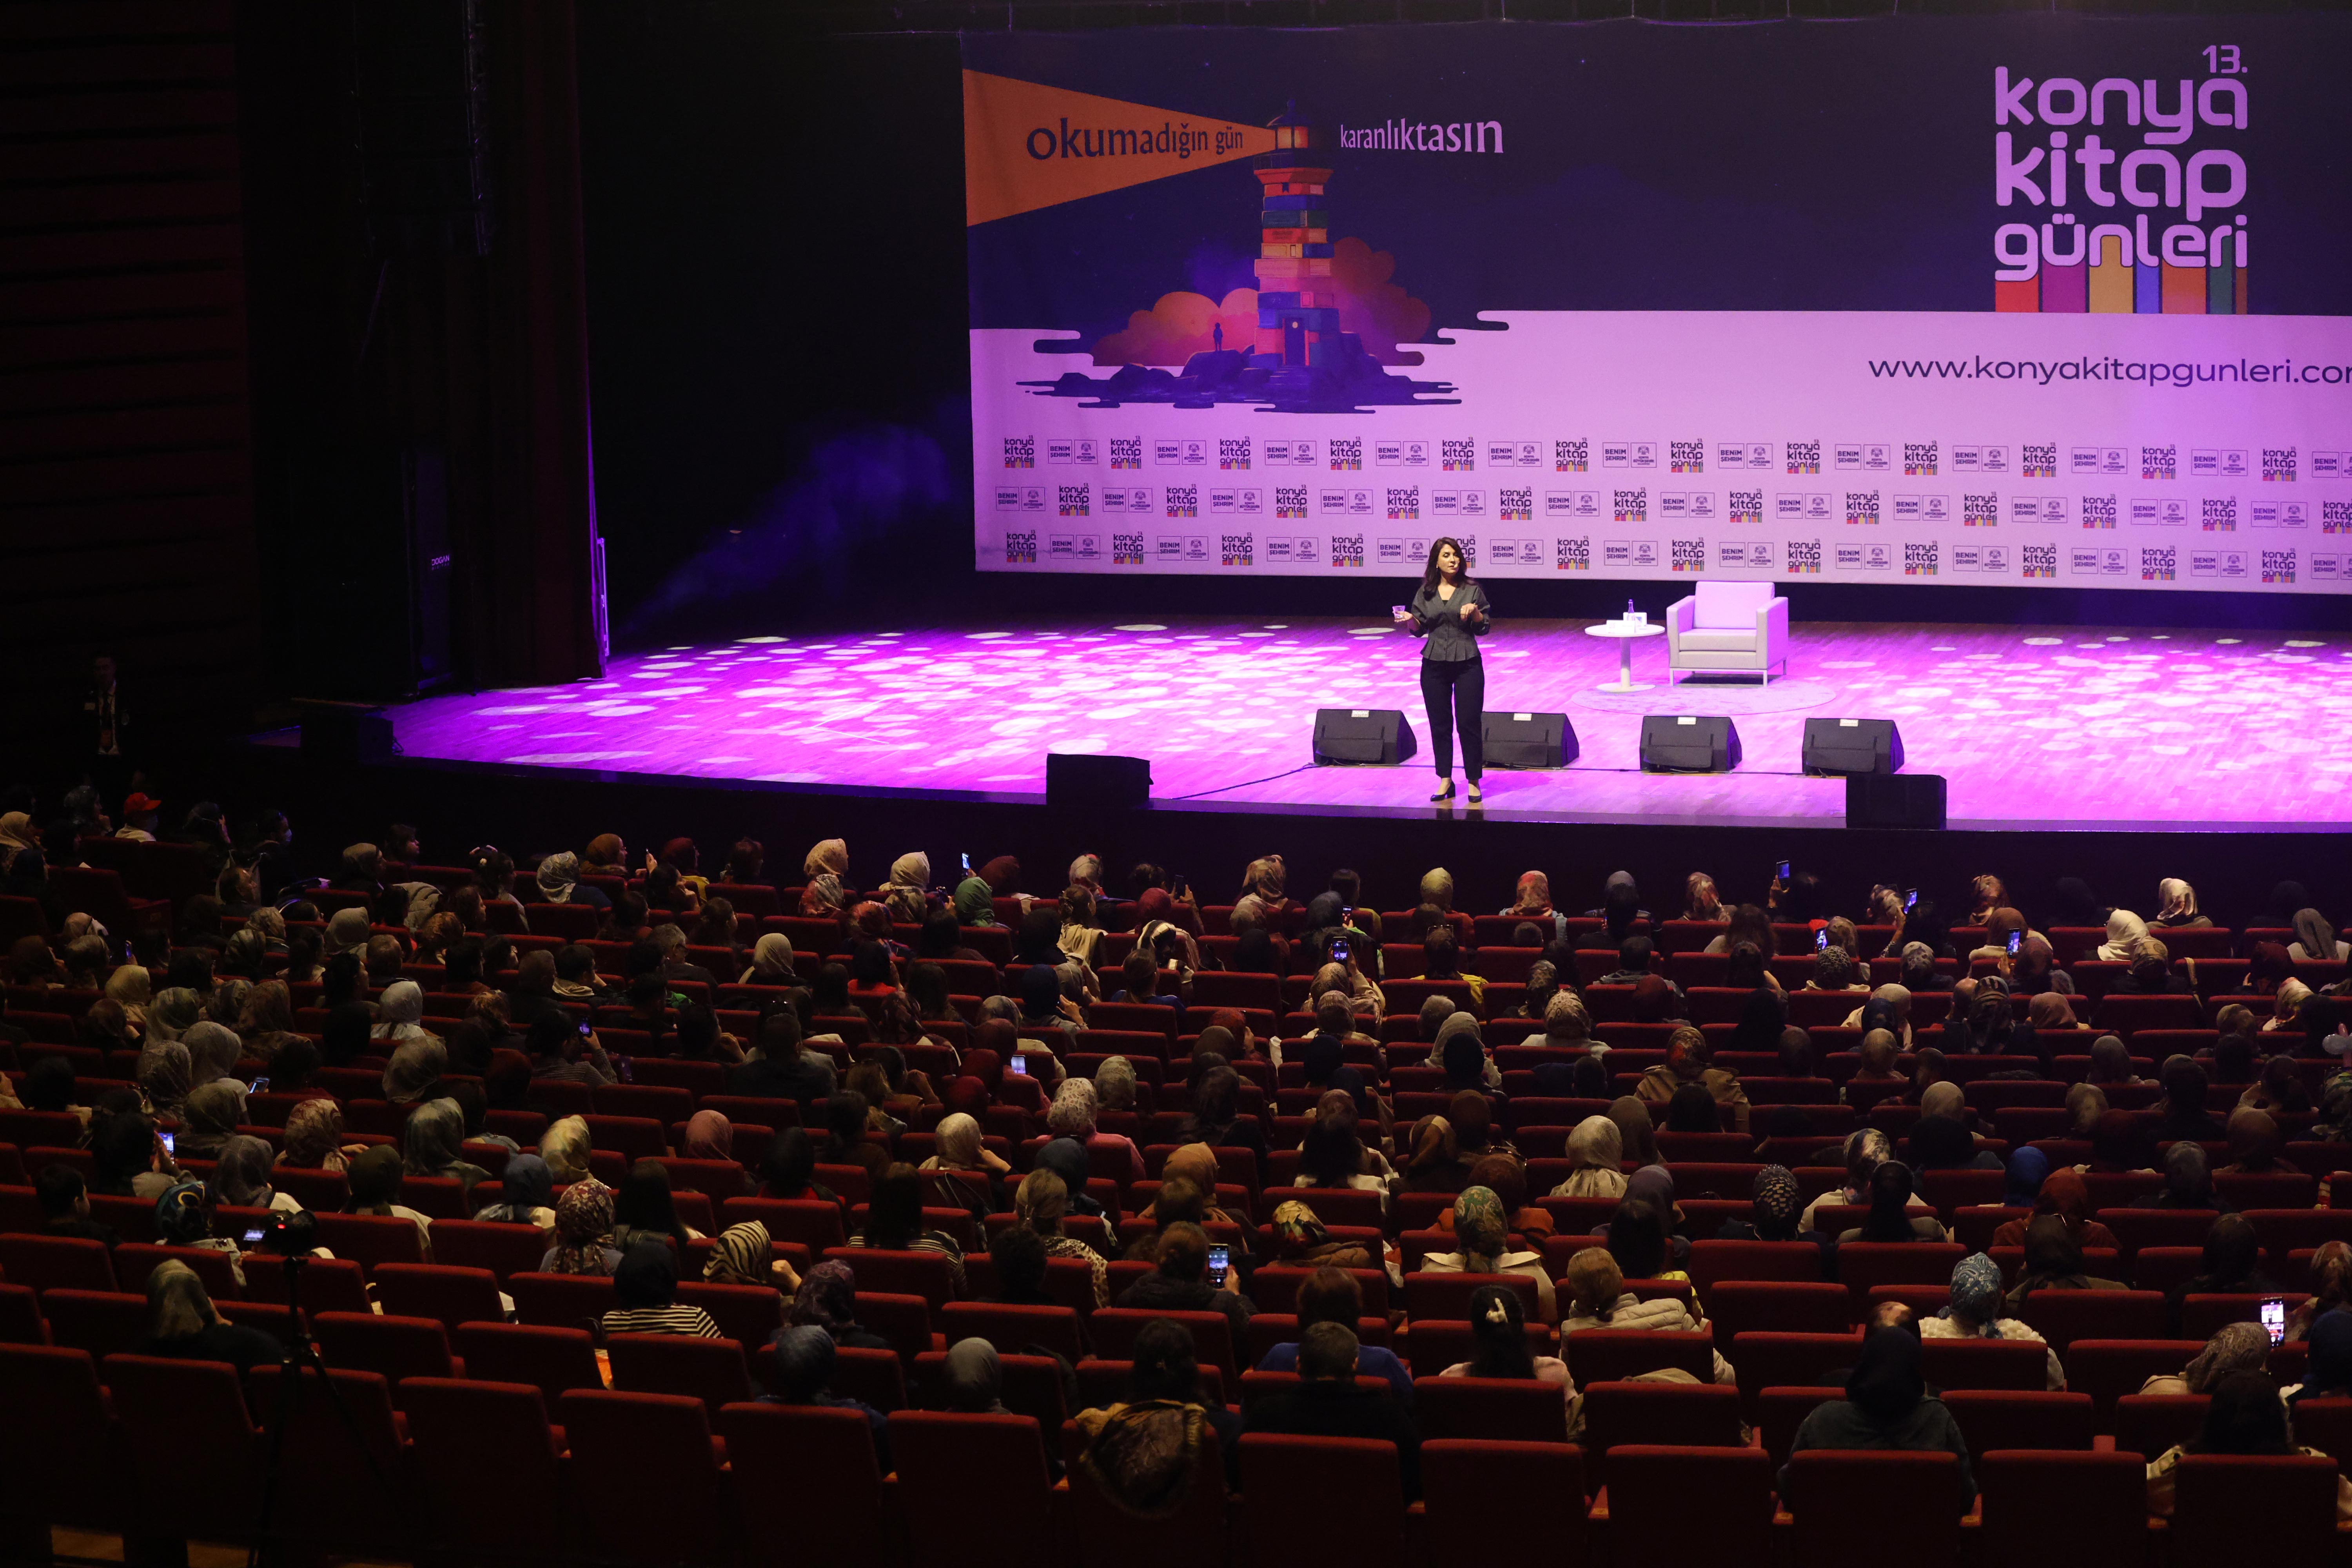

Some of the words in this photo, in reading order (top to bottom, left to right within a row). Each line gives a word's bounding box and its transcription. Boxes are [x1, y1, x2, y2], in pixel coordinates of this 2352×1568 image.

[2202, 45, 2248, 74] 13.
[1995, 66, 2248, 145] konya
[1026, 117, 1209, 160] okumadığın
[1215, 128, 1244, 155] gün
[1340, 118, 1504, 153] karanlıktasın
[1996, 131, 2247, 221] kitap
[1994, 214, 2248, 281] günleri
[1005, 437, 1034, 447] konya
[1111, 438, 1141, 448] konya
[1220, 439, 1250, 448] konya
[1330, 439, 1361, 449] konya
[1443, 439, 1474, 449] konya
[1556, 440, 1588, 450] konya
[1671, 441, 1703, 451] konya
[1787, 442, 1820, 452] konya
[1005, 446, 1034, 457] kitap
[1111, 447, 1141, 458] kitap
[1220, 447, 1250, 458] kitap
[1330, 448, 1361, 459] kitap
[1443, 448, 1474, 459] kitap
[1905, 443, 1937, 453] konya
[1556, 448, 1588, 460] kitap
[1671, 450, 1703, 461] kitap
[1787, 451, 1820, 462] kitap
[1905, 452, 1937, 463] kitap
[1059, 485, 1089, 495] konya
[1167, 486, 1197, 495] konya
[1276, 487, 1307, 497] konya
[1387, 488, 1419, 497] konya
[1501, 489, 1532, 499] konya
[1614, 490, 1646, 499] konya
[1059, 494, 1089, 505] kitap
[1167, 495, 1197, 506] kitap
[1276, 495, 1307, 507] kitap
[1730, 491, 1762, 501] konya
[1847, 493, 1879, 502] konya
[1387, 496, 1419, 508] kitap
[1501, 497, 1532, 509] kitap
[1614, 499, 1646, 510] kitap
[1730, 500, 1762, 511] kitap
[1847, 501, 1879, 512] kitap
[1007, 532, 1036, 541] konya
[1113, 533, 1143, 543] konya
[1222, 534, 1252, 544] konya
[1332, 536, 1363, 545] konya
[1007, 541, 1036, 552] kitap
[1113, 542, 1143, 553] kitap
[1222, 543, 1252, 554] kitap
[1557, 538, 1589, 548] konya
[1672, 540, 1704, 549] konya
[1788, 541, 1820, 551] konya
[1905, 543, 1938, 553] konya
[1332, 544, 1363, 555] kitap
[1557, 547, 1589, 558] kitap
[1672, 548, 1704, 559] kitap
[1788, 550, 1820, 561] kitap
[1905, 552, 1938, 563] kitap
